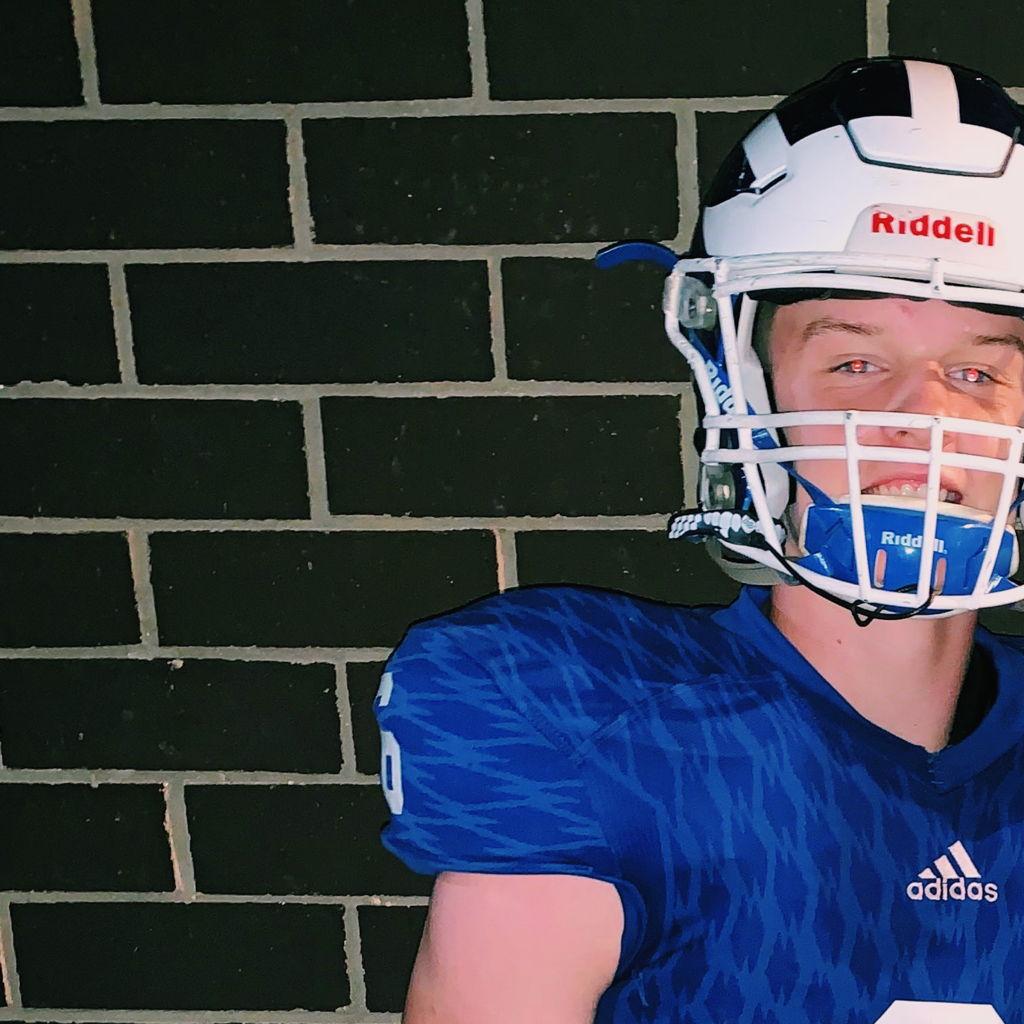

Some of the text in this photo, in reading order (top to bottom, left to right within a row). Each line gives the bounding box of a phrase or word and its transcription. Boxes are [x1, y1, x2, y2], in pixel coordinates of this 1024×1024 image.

[872, 211, 995, 246] Riddell
[881, 531, 945, 553] Riddll
[906, 877, 998, 902] adidas
